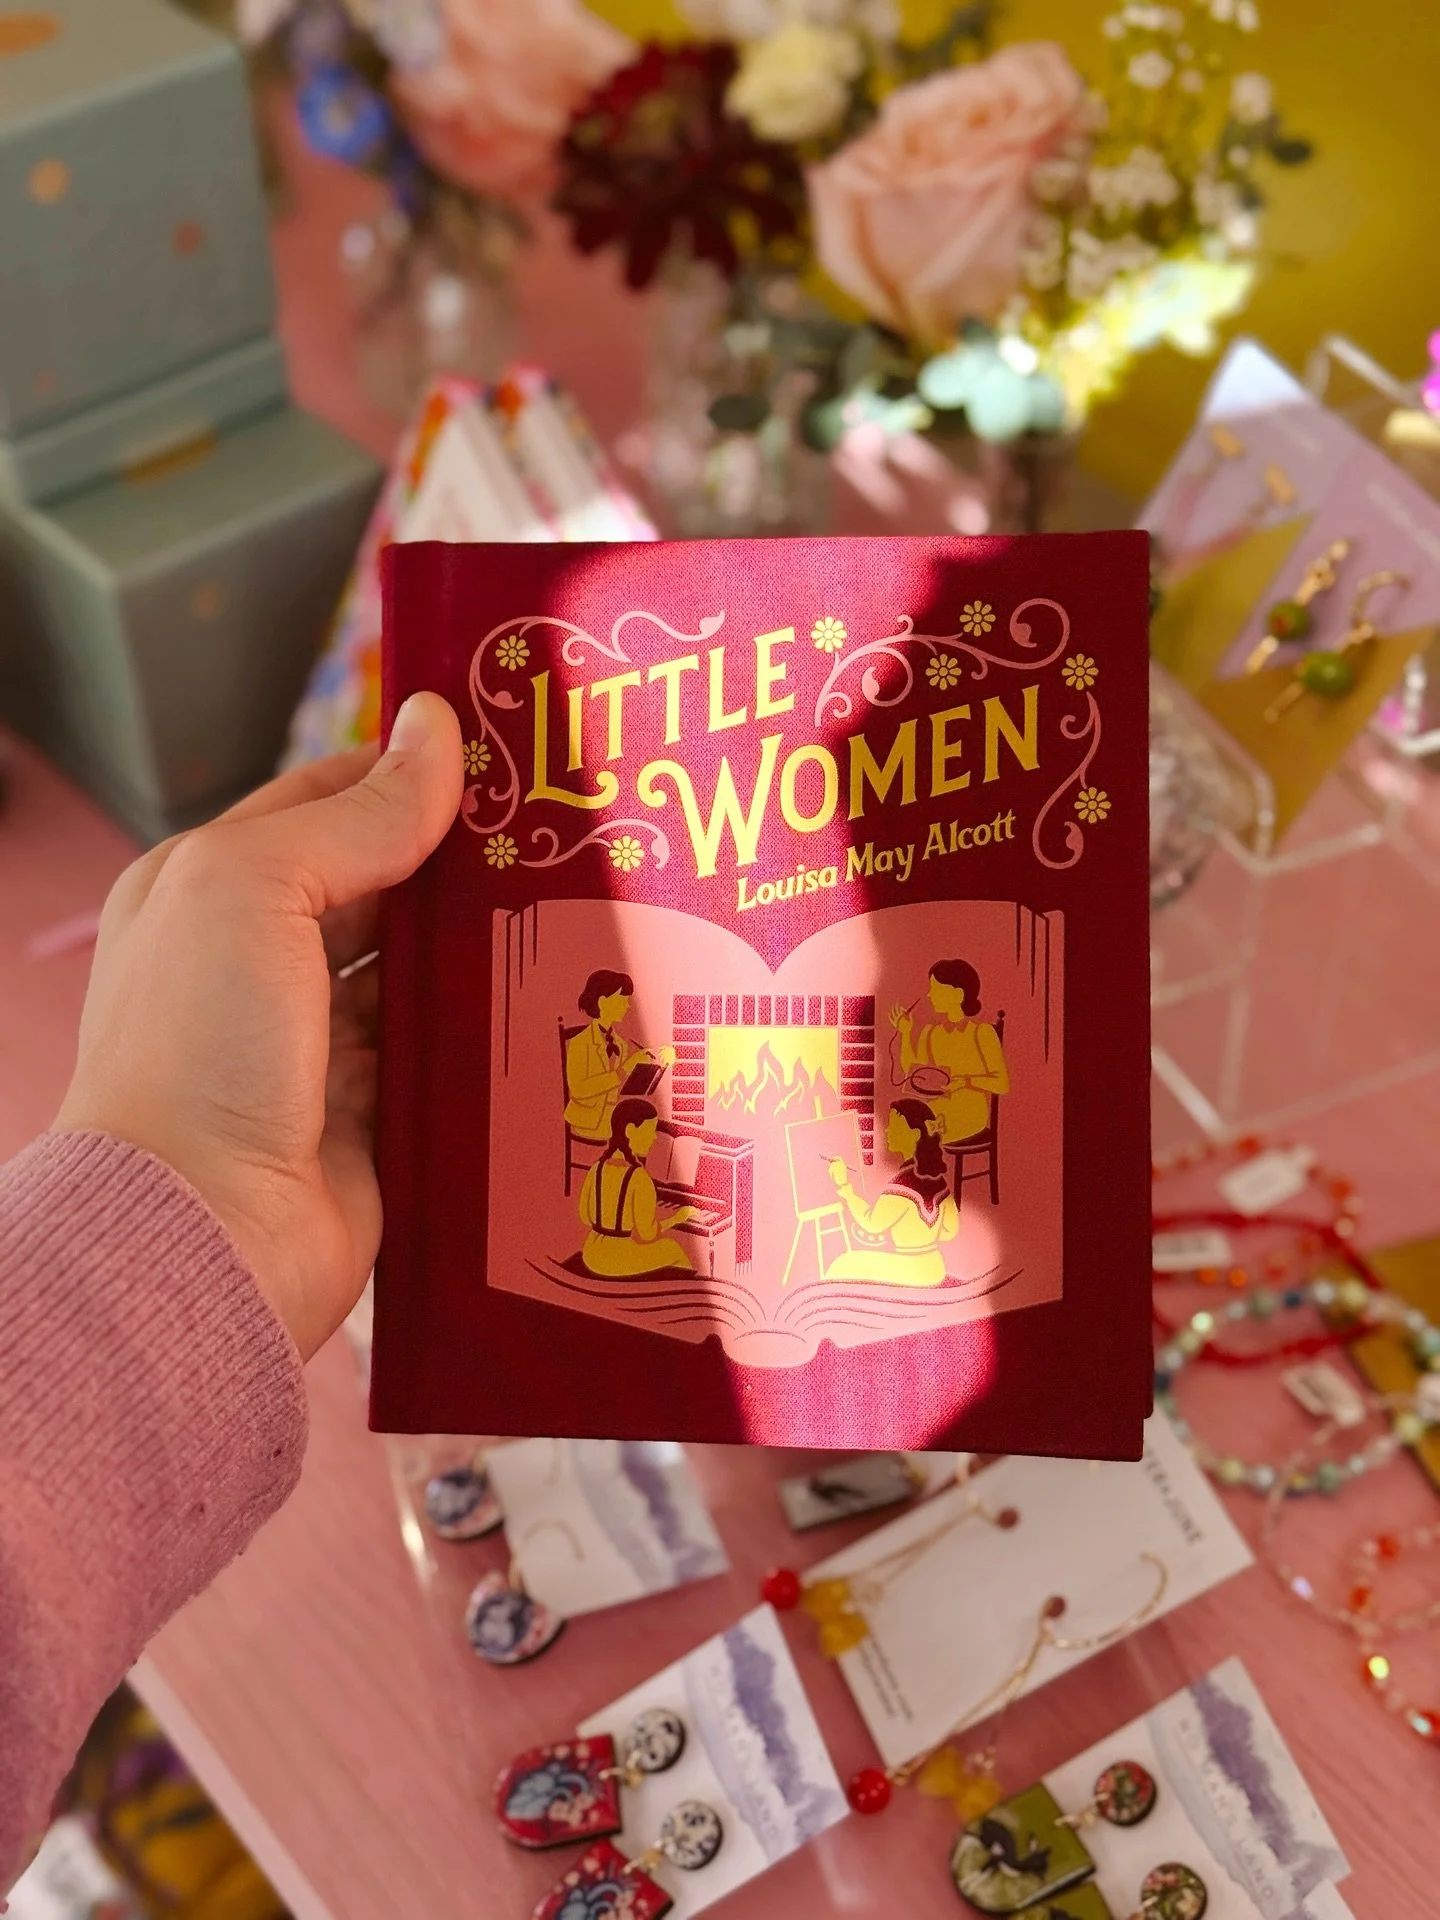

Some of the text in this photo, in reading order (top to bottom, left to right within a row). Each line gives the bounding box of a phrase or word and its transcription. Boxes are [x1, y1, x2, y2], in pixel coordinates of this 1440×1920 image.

[525, 626, 796, 810] LITTLE
[637, 684, 1041, 878] WOMEN
[736, 809, 1016, 912] Louisa May Alcott
